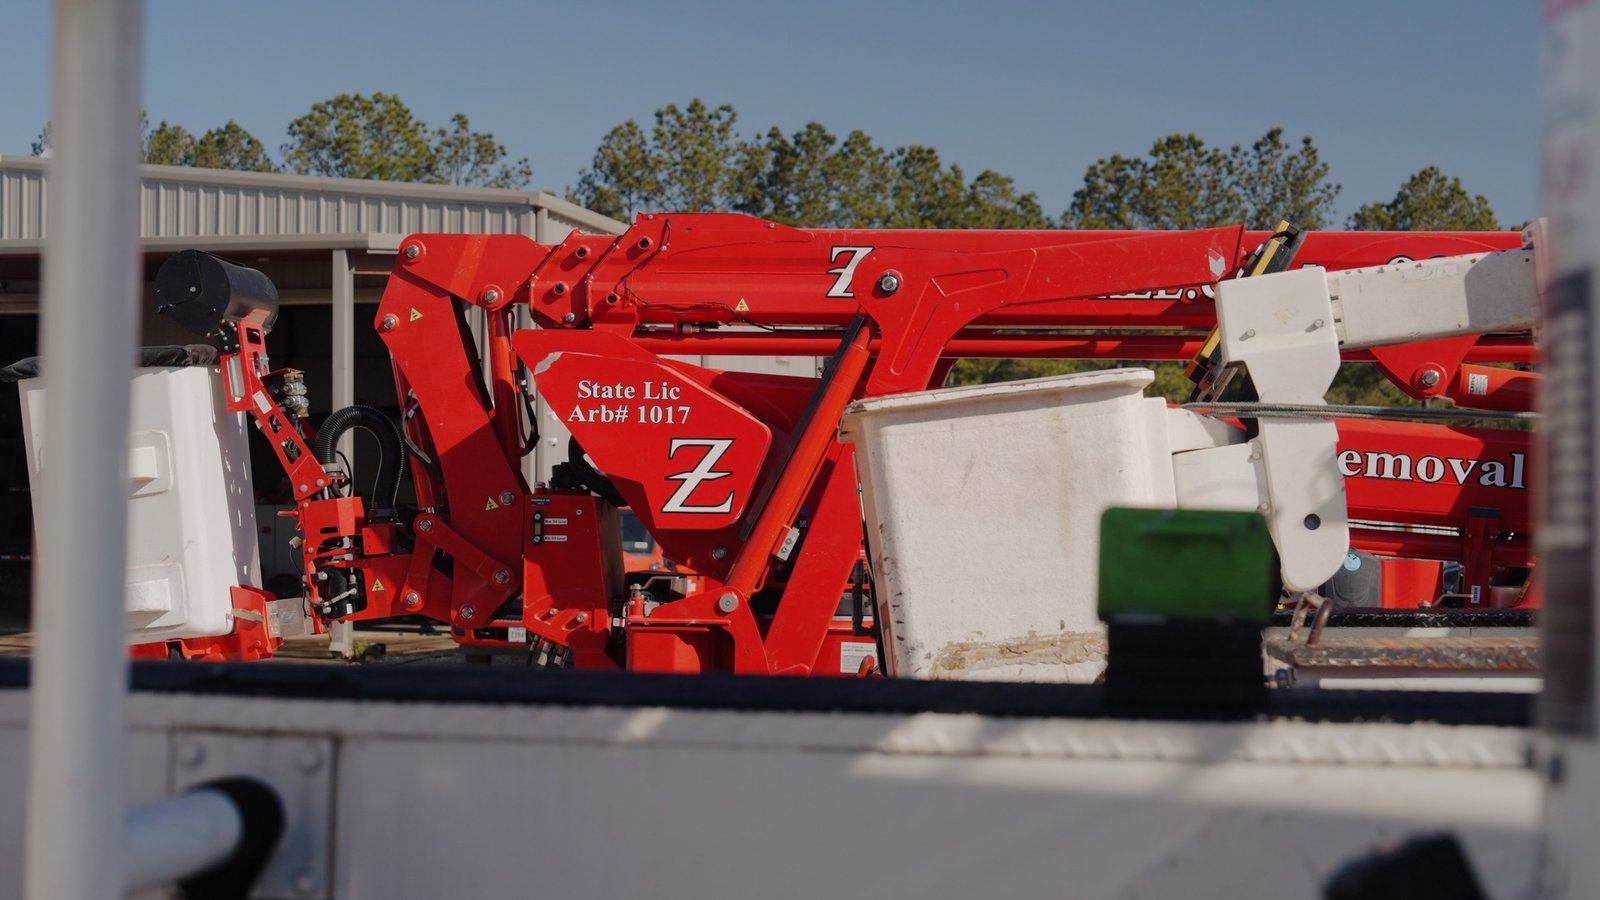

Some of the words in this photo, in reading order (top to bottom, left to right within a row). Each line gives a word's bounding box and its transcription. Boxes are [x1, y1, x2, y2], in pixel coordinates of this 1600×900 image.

[577, 380, 636, 399] State
[643, 381, 681, 400] Lic
[568, 404, 629, 424] Arb#
[637, 405, 691, 425] 1017
[660, 437, 736, 514] Z
[1337, 448, 1527, 489] emoval
